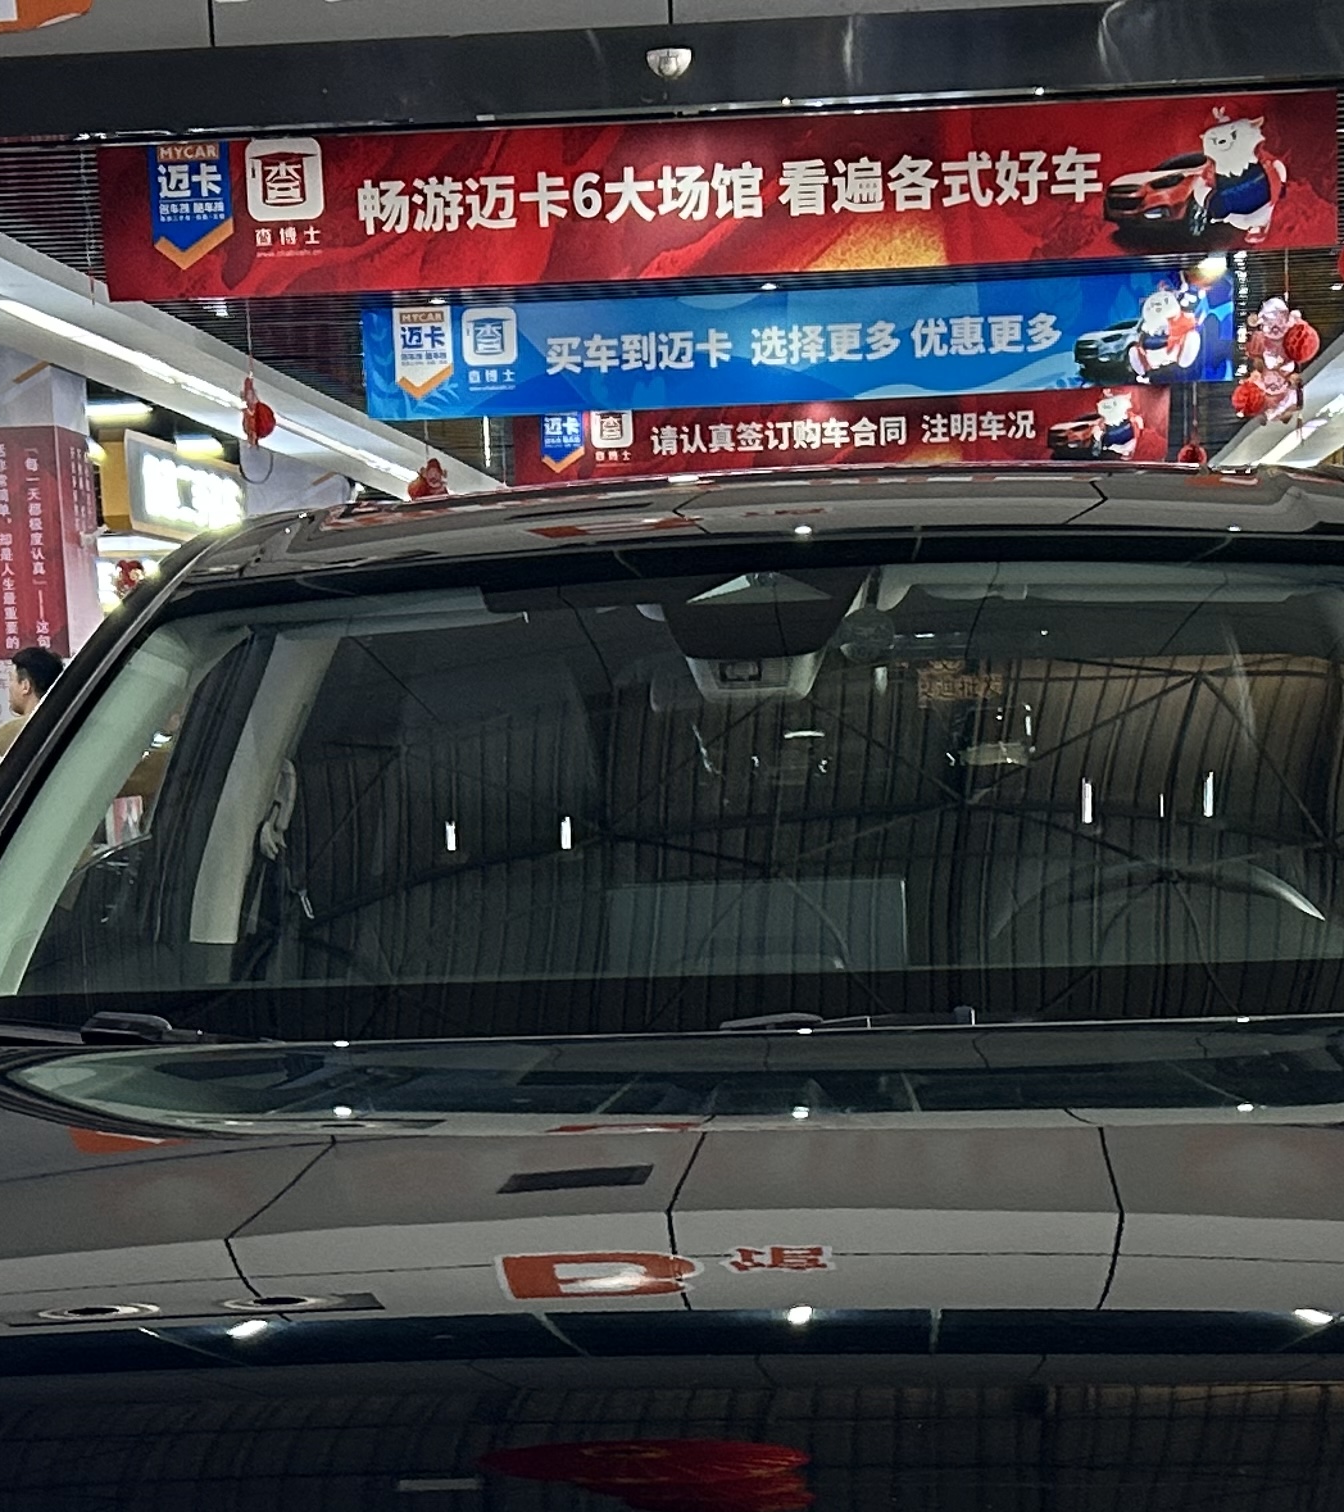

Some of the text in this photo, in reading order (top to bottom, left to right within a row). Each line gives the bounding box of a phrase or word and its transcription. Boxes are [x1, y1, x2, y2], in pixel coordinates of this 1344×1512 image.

[159, 145, 218, 160] MYCAR
[158, 163, 222, 198] 迈卡
[357, 147, 1102, 235] 畅游迈卡6大场馆 看遍各式好车
[255, 226, 321, 247] 查博士
[400, 312, 443, 323] MYCAR
[400, 326, 445, 349] 迈卡
[546, 312, 1062, 375] 买车到迈卡 选择更多 优惠更多
[544, 416, 580, 435] 迈卡
[650, 410, 1036, 456] 请认真签订购车合同 注明车况
